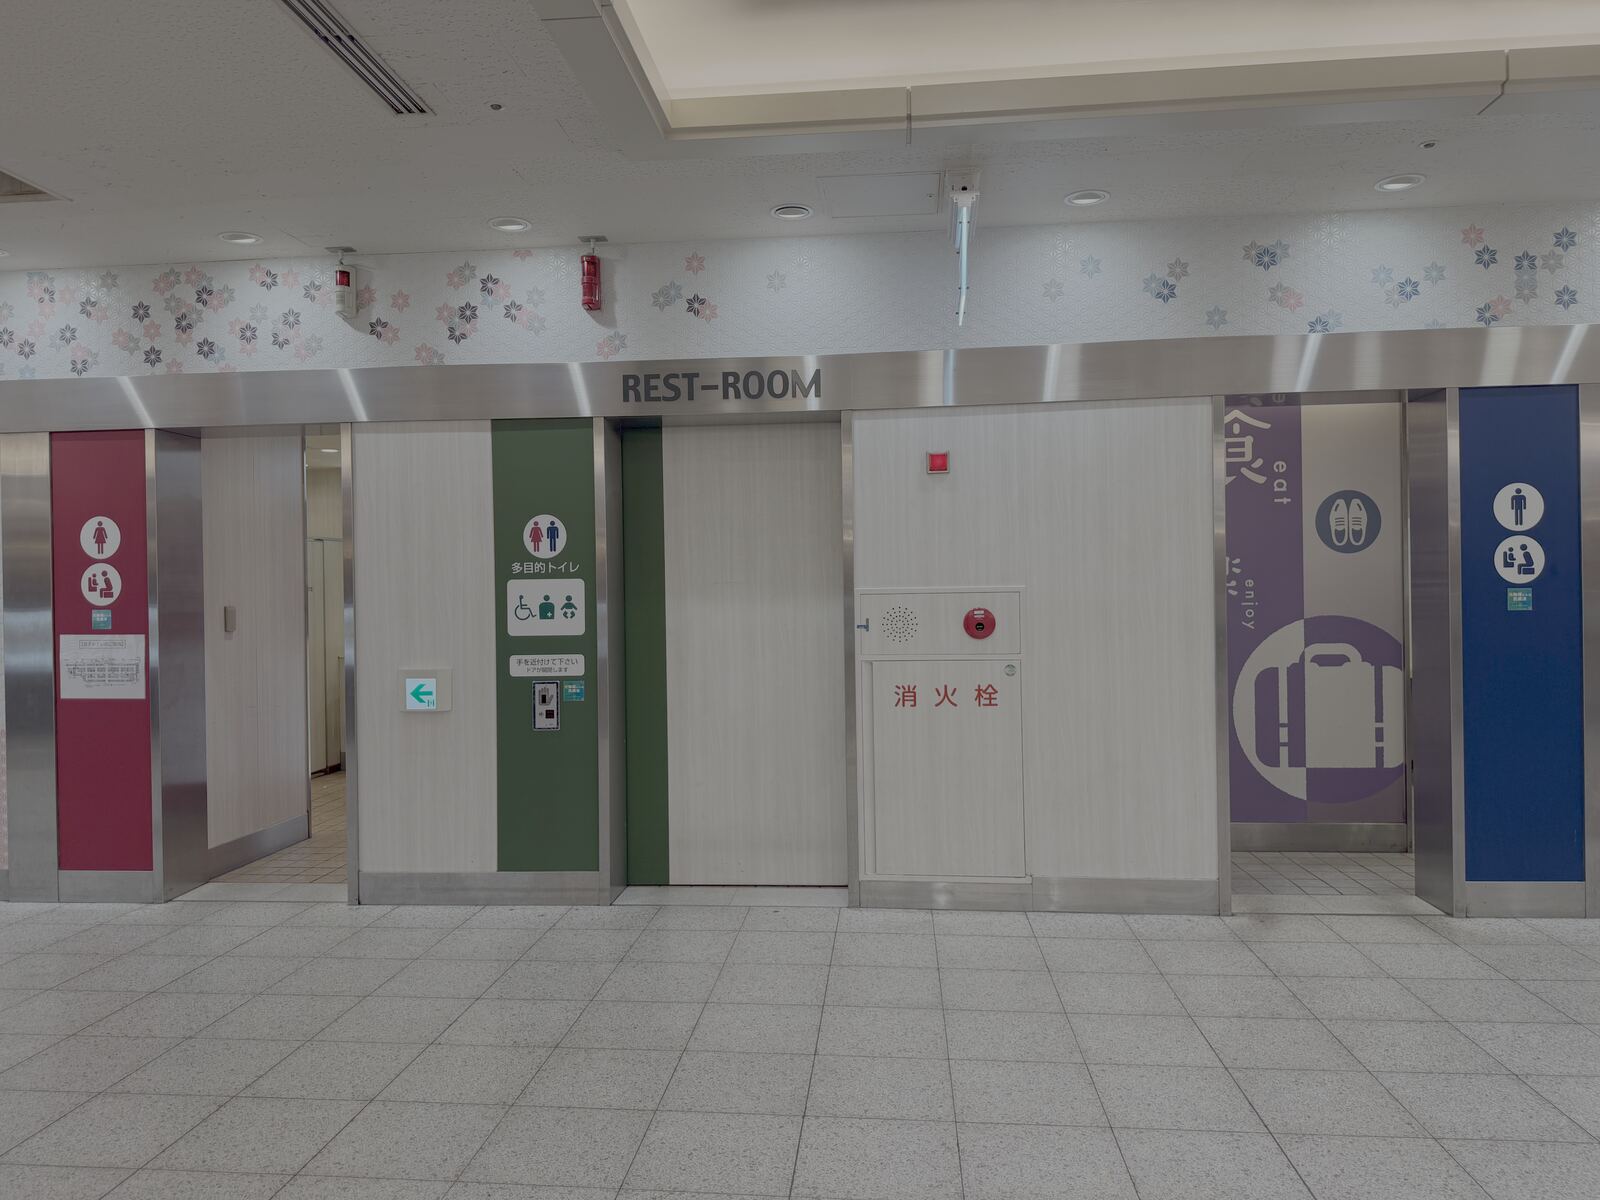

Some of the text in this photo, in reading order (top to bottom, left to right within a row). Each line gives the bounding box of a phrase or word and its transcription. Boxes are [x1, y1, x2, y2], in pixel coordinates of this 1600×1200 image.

[622, 368, 821, 403] REST-ROOM
[1273, 461, 1291, 504] eat
[511, 561, 580, 574] 多目的トイレ
[1241, 579, 1258, 629] enjoy
[894, 684, 999, 708] 消火栓
